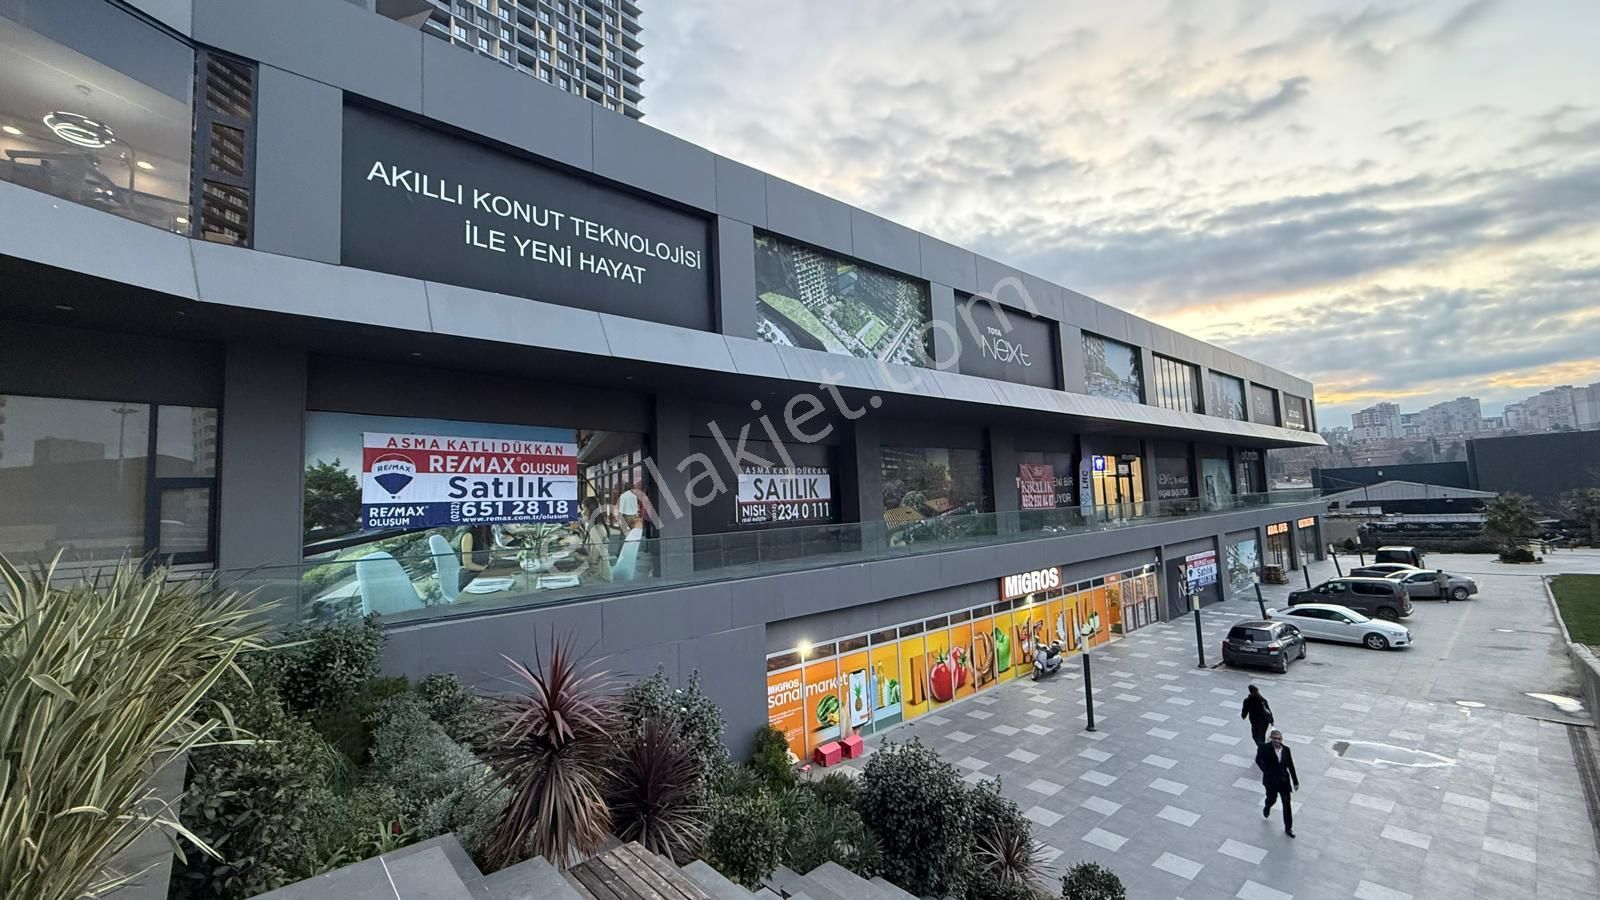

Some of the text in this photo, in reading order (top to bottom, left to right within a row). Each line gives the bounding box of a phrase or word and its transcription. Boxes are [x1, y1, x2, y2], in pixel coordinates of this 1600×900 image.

[367, 161, 702, 270] AKILLI KONUT TEKNOLOJİSİ
[465, 220, 646, 284] İLE YENİ HAYAT
[387, 437, 564, 455] ASMA KATLI DÜKKAN
[377, 463, 411, 473] RE/MAX
[429, 454, 570, 475] RE/MAX OLUŞUM
[745, 466, 770, 475] ASMA
[797, 466, 827, 475] DÜKKAN
[448, 476, 554, 499] Satılık
[753, 477, 819, 500] SATILIK
[1081, 470, 1089, 489] LRC
[369, 506, 425, 518] RE/MAX
[462, 501, 504, 517] 651
[512, 500, 540, 516] 28
[546, 500, 569, 515] 18
[742, 504, 766, 517] NISH
[778, 503, 799, 520] 234
[802, 503, 809, 518] 0
[812, 502, 829, 517] 111
[369, 518, 410, 527] OLUŞUM
[462, 513, 569, 523] www.remax.com.tr/olusum
